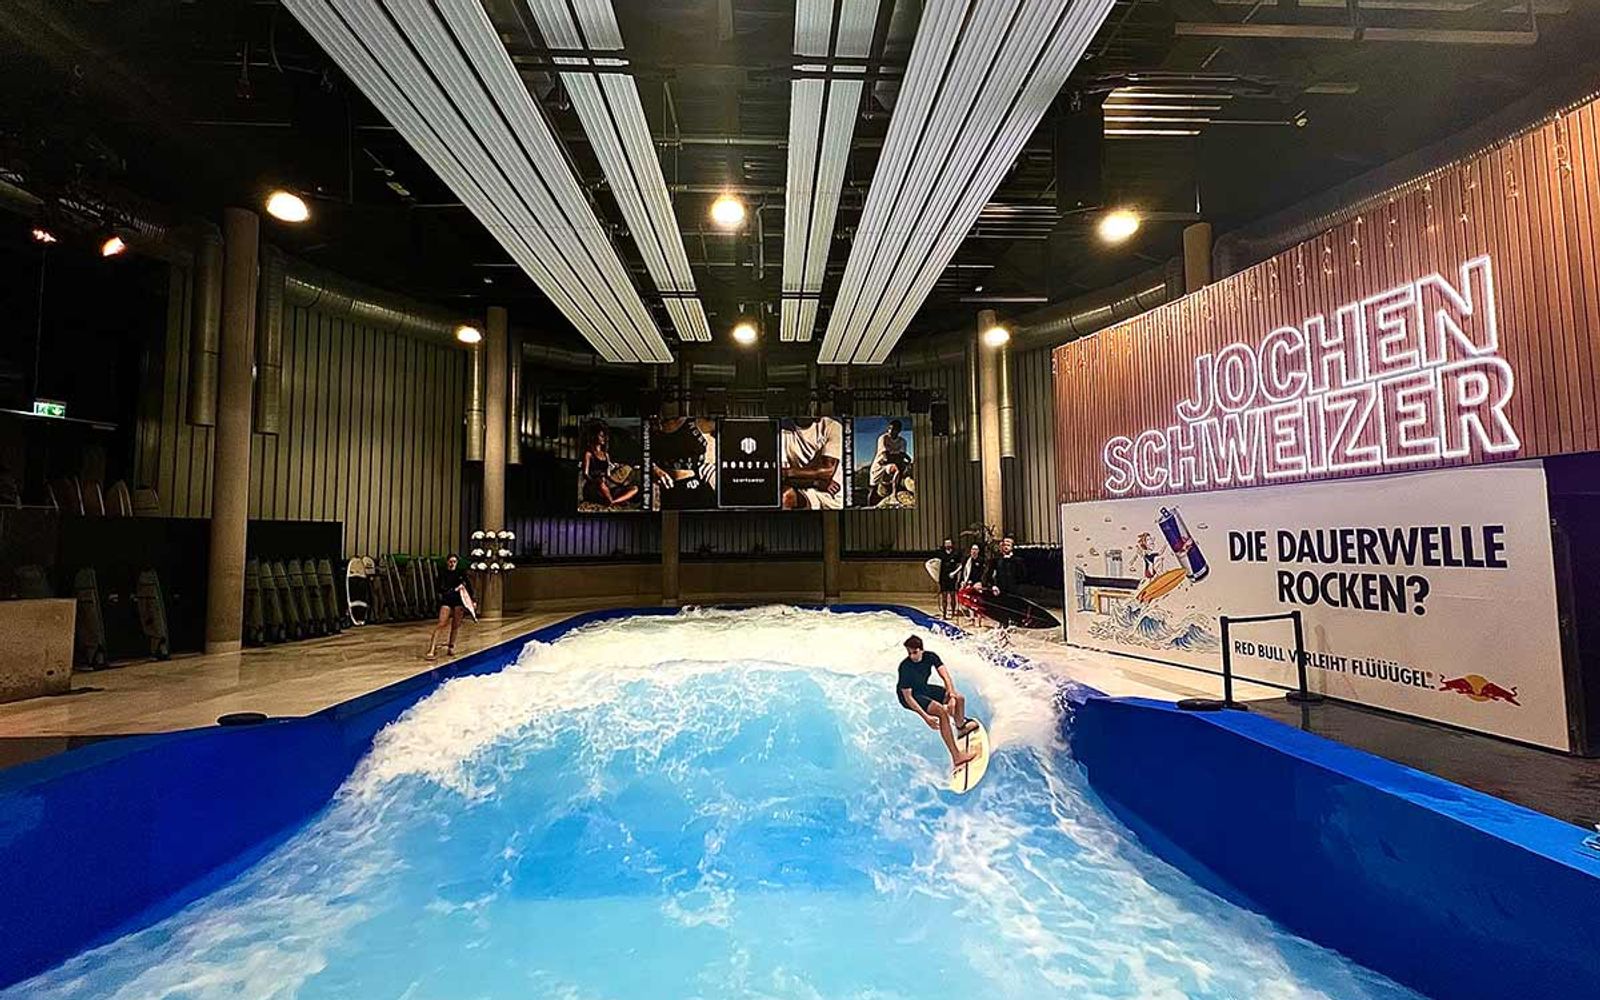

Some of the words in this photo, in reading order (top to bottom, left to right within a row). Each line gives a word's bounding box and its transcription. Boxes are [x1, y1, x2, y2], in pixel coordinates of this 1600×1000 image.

[1176, 255, 1499, 422] JOCHEN
[1104, 356, 1521, 494] SCHWEIZER
[1229, 531, 1268, 561] DIE
[1277, 525, 1507, 568] DAUERWELLE
[1277, 570, 1429, 615] ROCKEN?
[1234, 640, 1254, 656] RED
[1258, 644, 1286, 662] BULL
[1288, 649, 1347, 673] VRLEIHT
